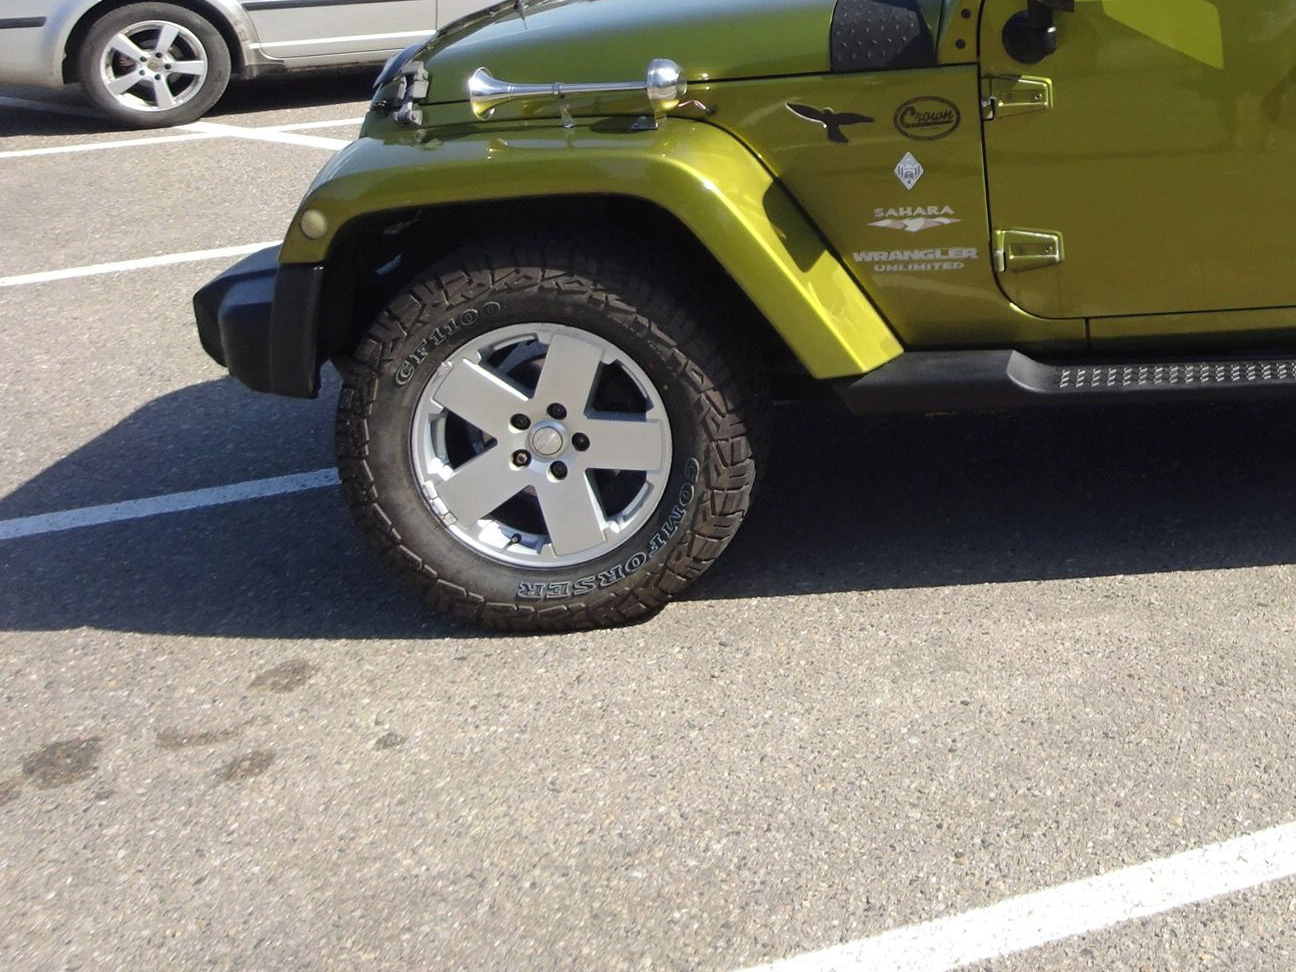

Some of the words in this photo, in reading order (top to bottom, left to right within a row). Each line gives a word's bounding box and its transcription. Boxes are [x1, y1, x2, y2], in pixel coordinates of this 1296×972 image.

[899, 106, 955, 128] Crown
[874, 205, 955, 218] SAHARA
[852, 247, 979, 262] WRANGLER
[873, 261, 965, 273] UNLIMITED
[395, 301, 501, 386] CF1100
[517, 457, 700, 599] COMFORSER
